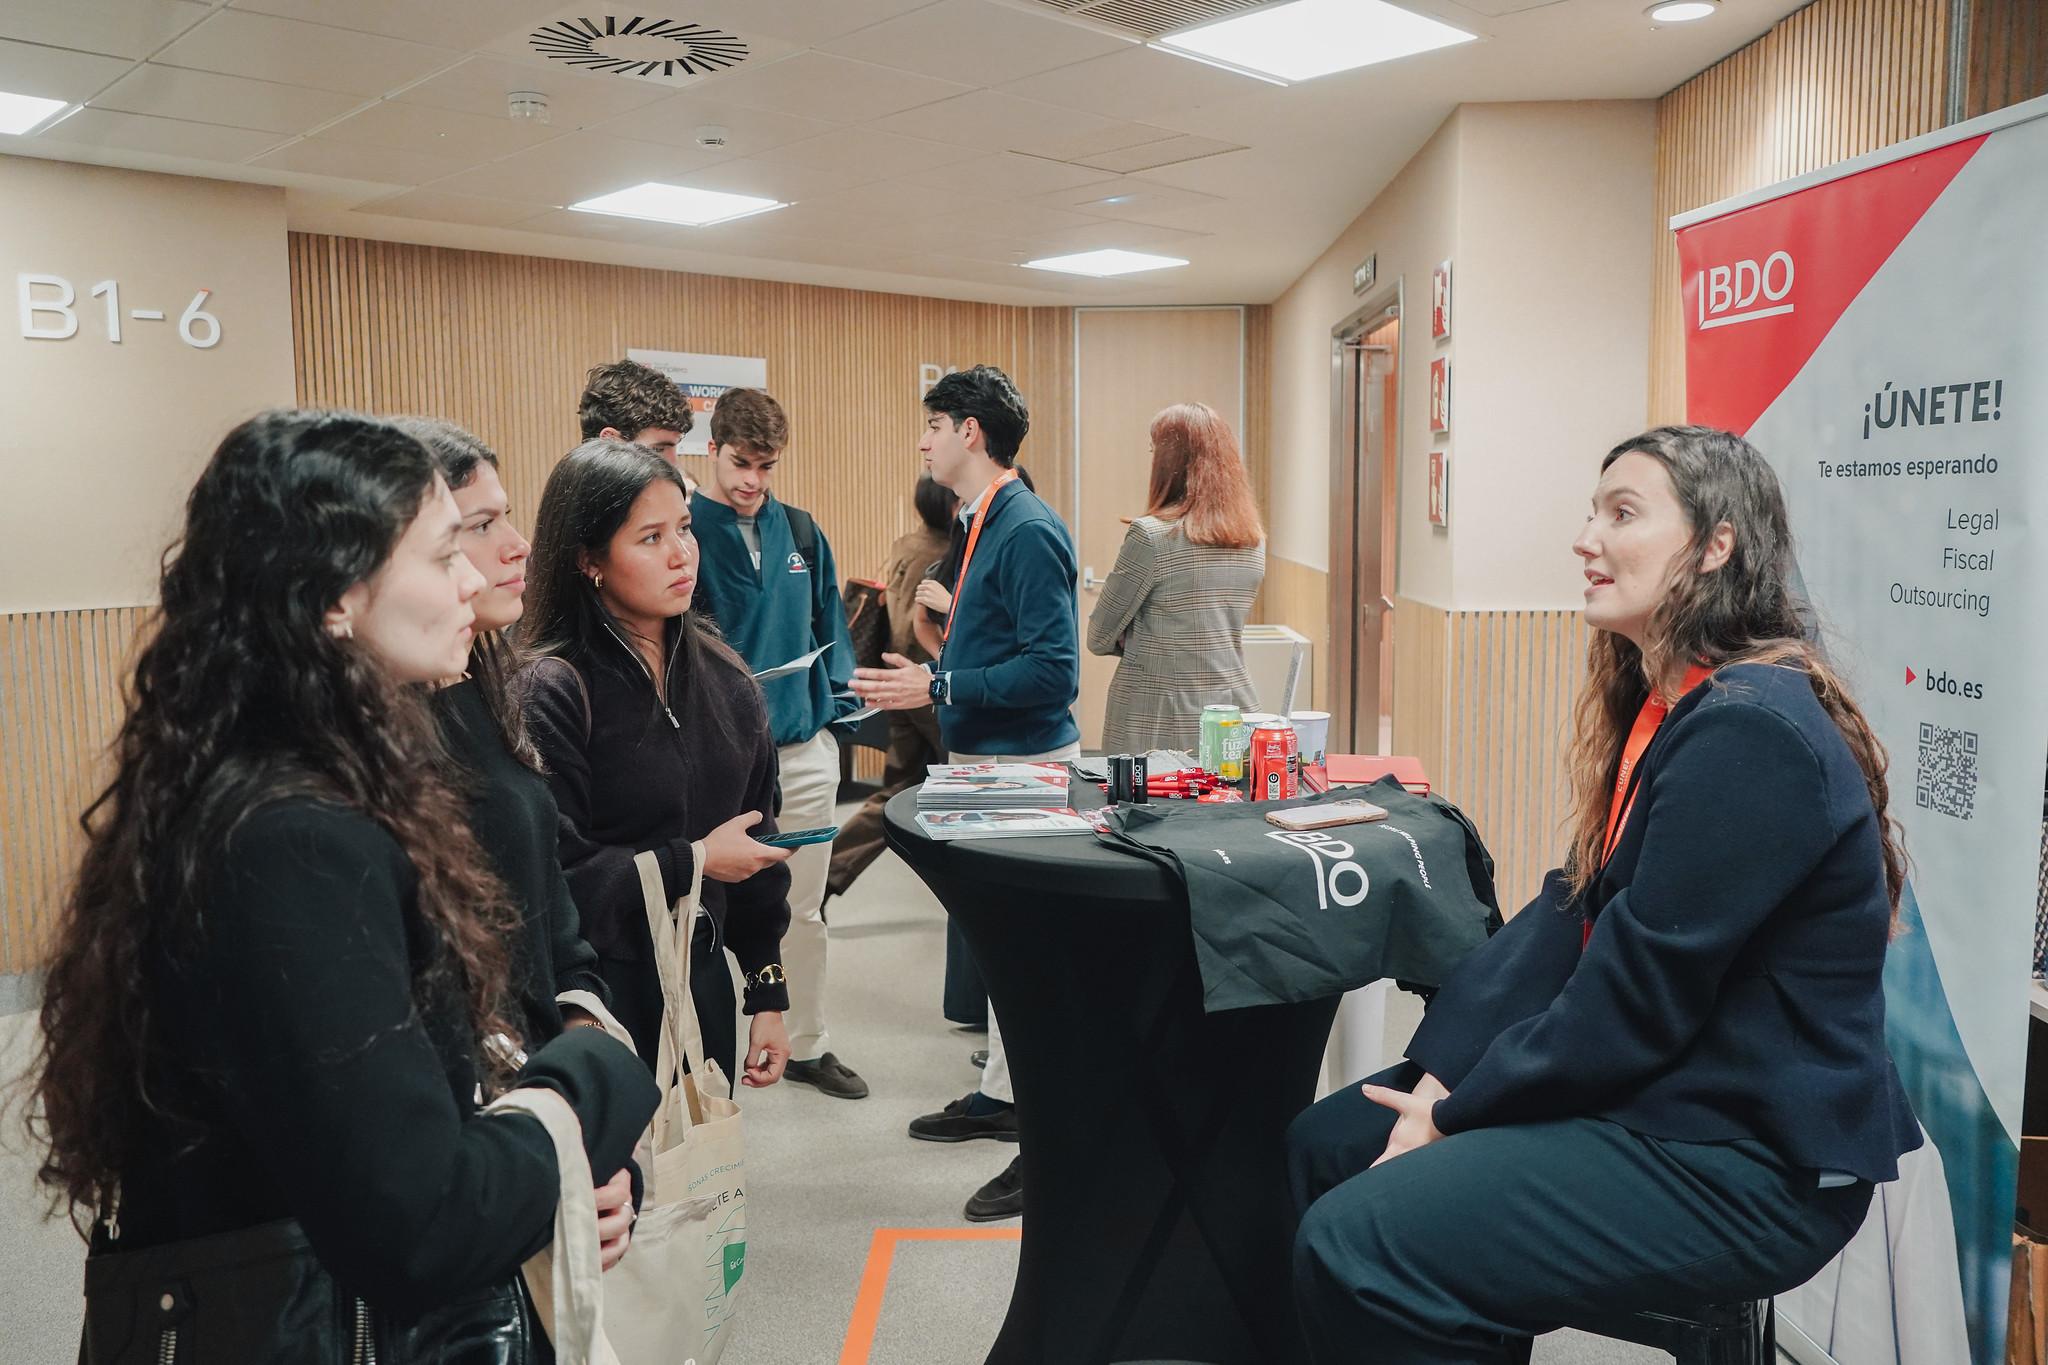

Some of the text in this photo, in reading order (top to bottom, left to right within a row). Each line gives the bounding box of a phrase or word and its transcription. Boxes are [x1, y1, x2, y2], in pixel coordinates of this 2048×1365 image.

[1700, 251, 1795, 320] BDO
[18, 273, 222, 349] B1-6
[1863, 379, 2003, 440] ¡ÚNETE!
[1818, 453, 1999, 480] Te estamos esperando
[1947, 507, 1999, 536] Legal
[1943, 547, 1995, 572] Fiscal
[1890, 582, 1991, 618] Outsourcing
[1926, 668, 1984, 700] bdo.es
[1221, 738, 1244, 750] fuz
[1221, 749, 1241, 760] tea
[1134, 764, 1143, 786] BDO
[1270, 831, 1370, 907] BDO
